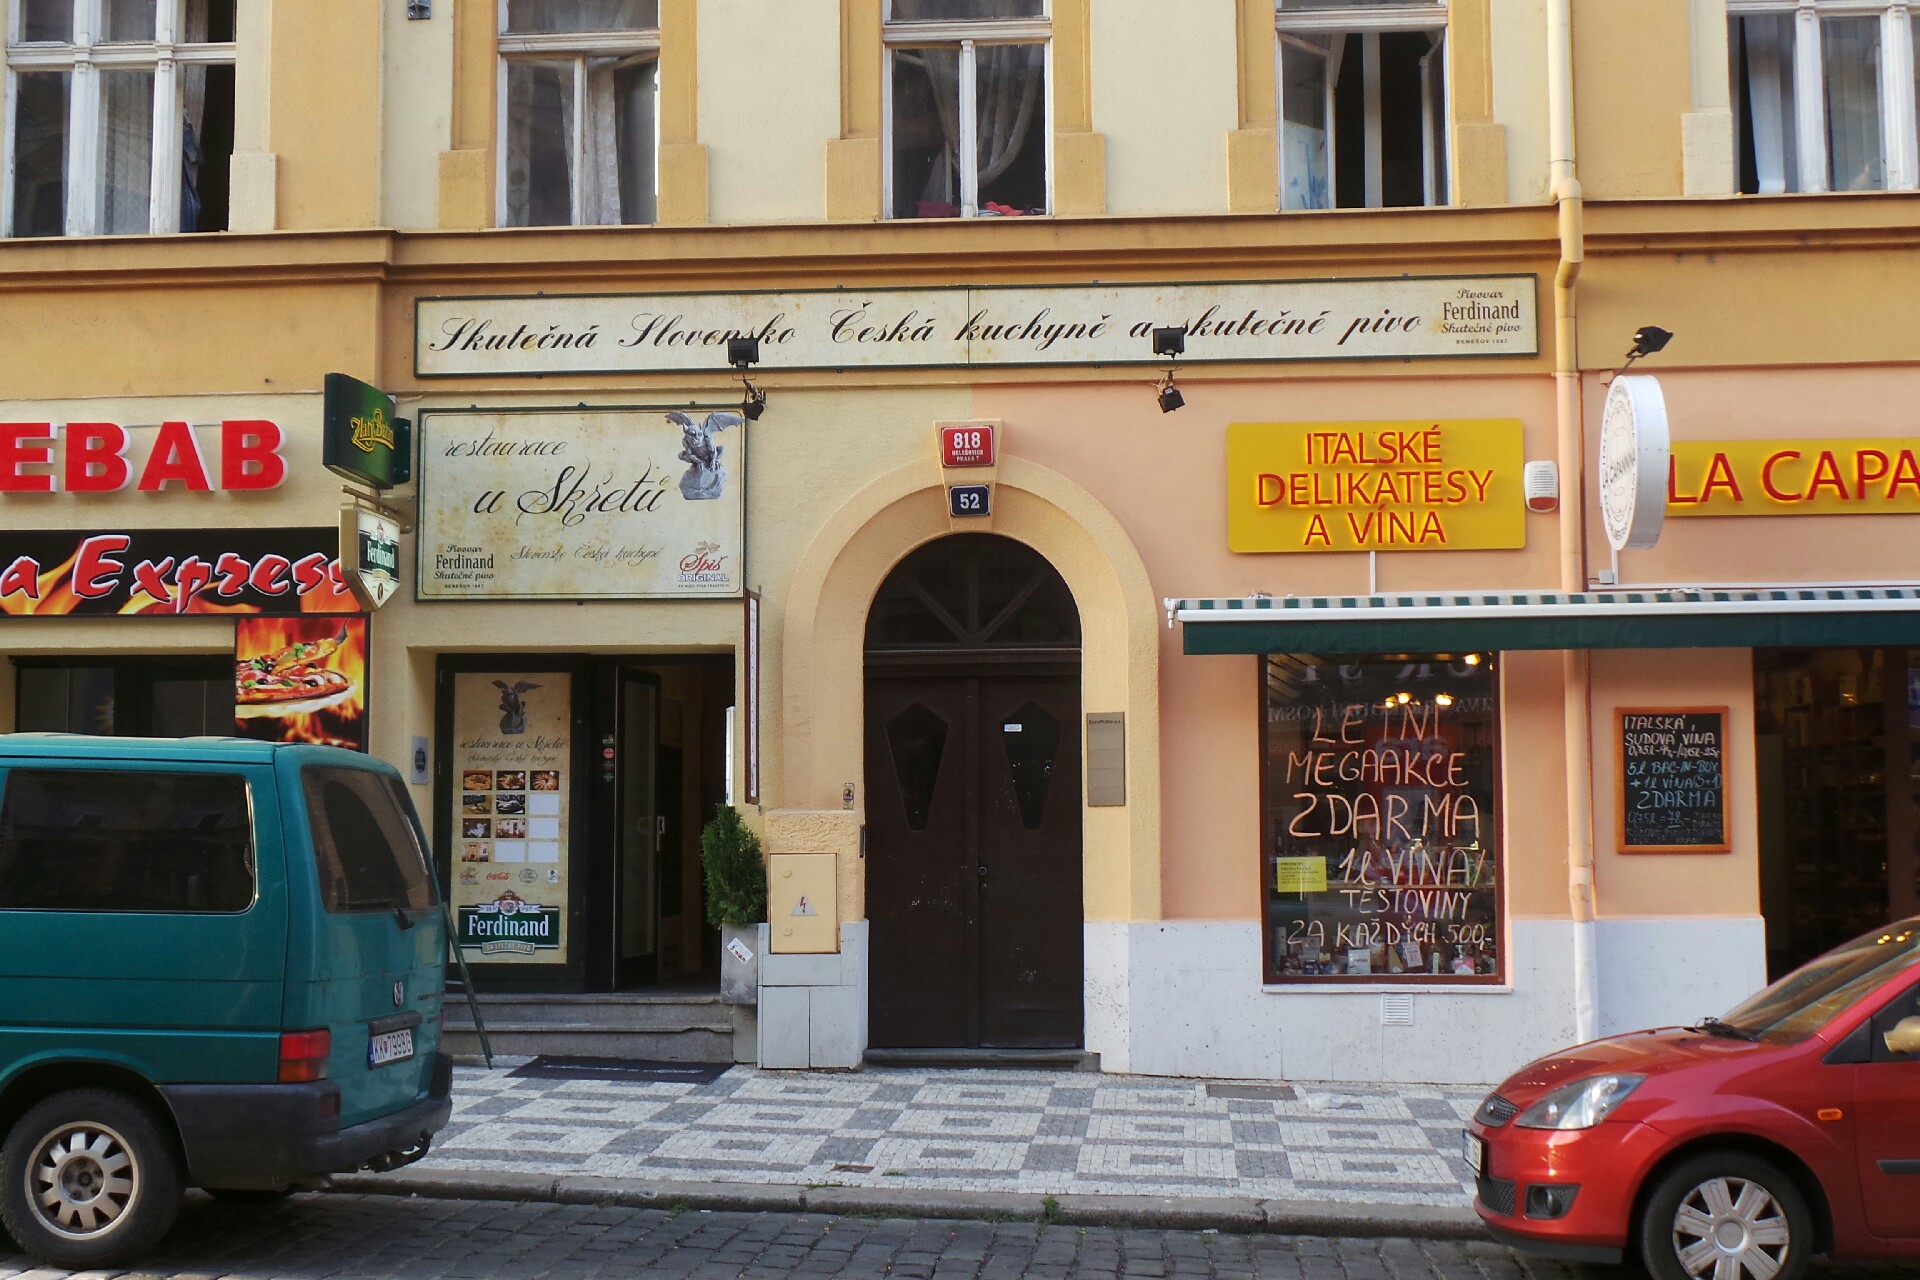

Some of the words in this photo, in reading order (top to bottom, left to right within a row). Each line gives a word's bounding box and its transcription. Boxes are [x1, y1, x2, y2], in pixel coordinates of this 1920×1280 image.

[1457, 287, 1504, 299] Pivovar
[1443, 300, 1519, 320] Ferdinand
[428, 314, 601, 353] Skutečná
[618, 311, 798, 348] Slovensko
[829, 301, 937, 344] Česká
[953, 307, 1114, 352] kuchyně
[1129, 319, 1155, 338] a
[1180, 304, 1332, 337] skutečné
[1336, 309, 1423, 346] pivo
[1441, 322, 1493, 333] Skutečné
[1495, 323, 1521, 335] pivo
[443, 424, 569, 456] restaurace
[953, 432, 981, 449] 818
[1305, 425, 1443, 465] ITALSKÉ
[0, 420, 289, 493] EBAB
[1257, 469, 1494, 506] DELIKATESY
[1668, 451, 1744, 503] LA
[516, 457, 672, 527] Skřetů
[960, 493, 980, 509] 52
[1303, 513, 1331, 546] A
[1350, 502, 1447, 545] VÍNA
[436, 554, 494, 569] Ferdinand
[680, 551, 728, 576] Spiš
[678, 573, 729, 582] ORIGINAL
[1624, 714, 1686, 730] ITALSKÁ
[1624, 730, 1676, 746] SUDOVÁ
[1682, 724, 1715, 745] VÍNA
[1286, 749, 1470, 788] MEGAAKCE
[1637, 790, 1716, 809] ZDARMA
[1288, 792, 1480, 841] ZDARMA
[468, 914, 549, 936] Ferdinand
[1287, 920, 1325, 947] ZA
